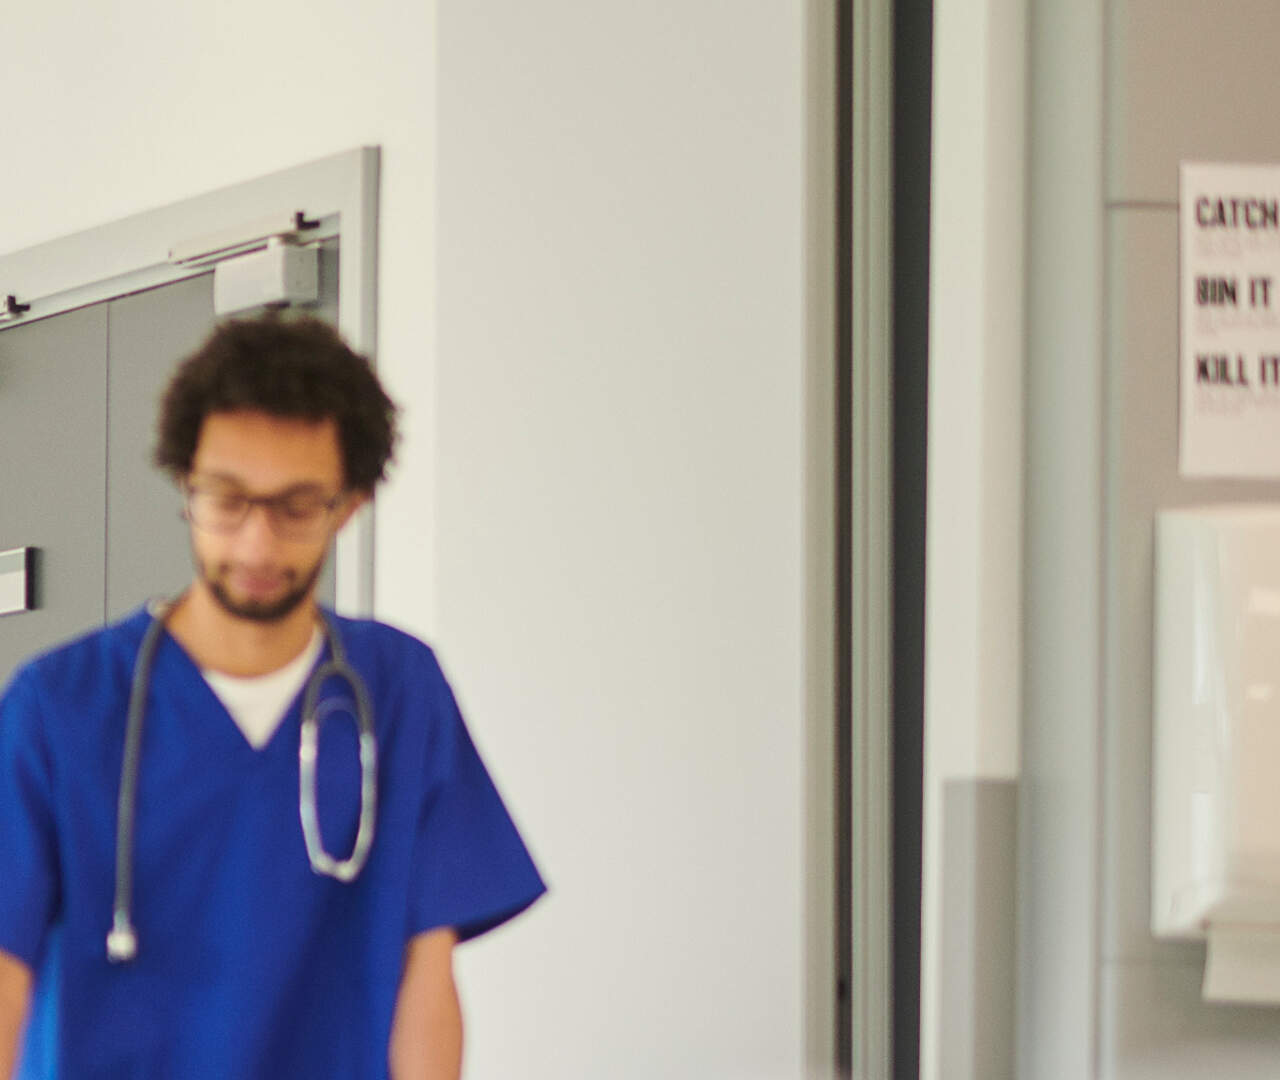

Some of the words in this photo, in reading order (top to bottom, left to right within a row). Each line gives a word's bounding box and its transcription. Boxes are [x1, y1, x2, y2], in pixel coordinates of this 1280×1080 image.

[1196, 198, 1278, 229] CATCH
[1196, 277, 1237, 306] BIN
[1249, 277, 1272, 307] IT
[1196, 354, 1248, 385] KILL
[1260, 354, 1280, 386] IT
